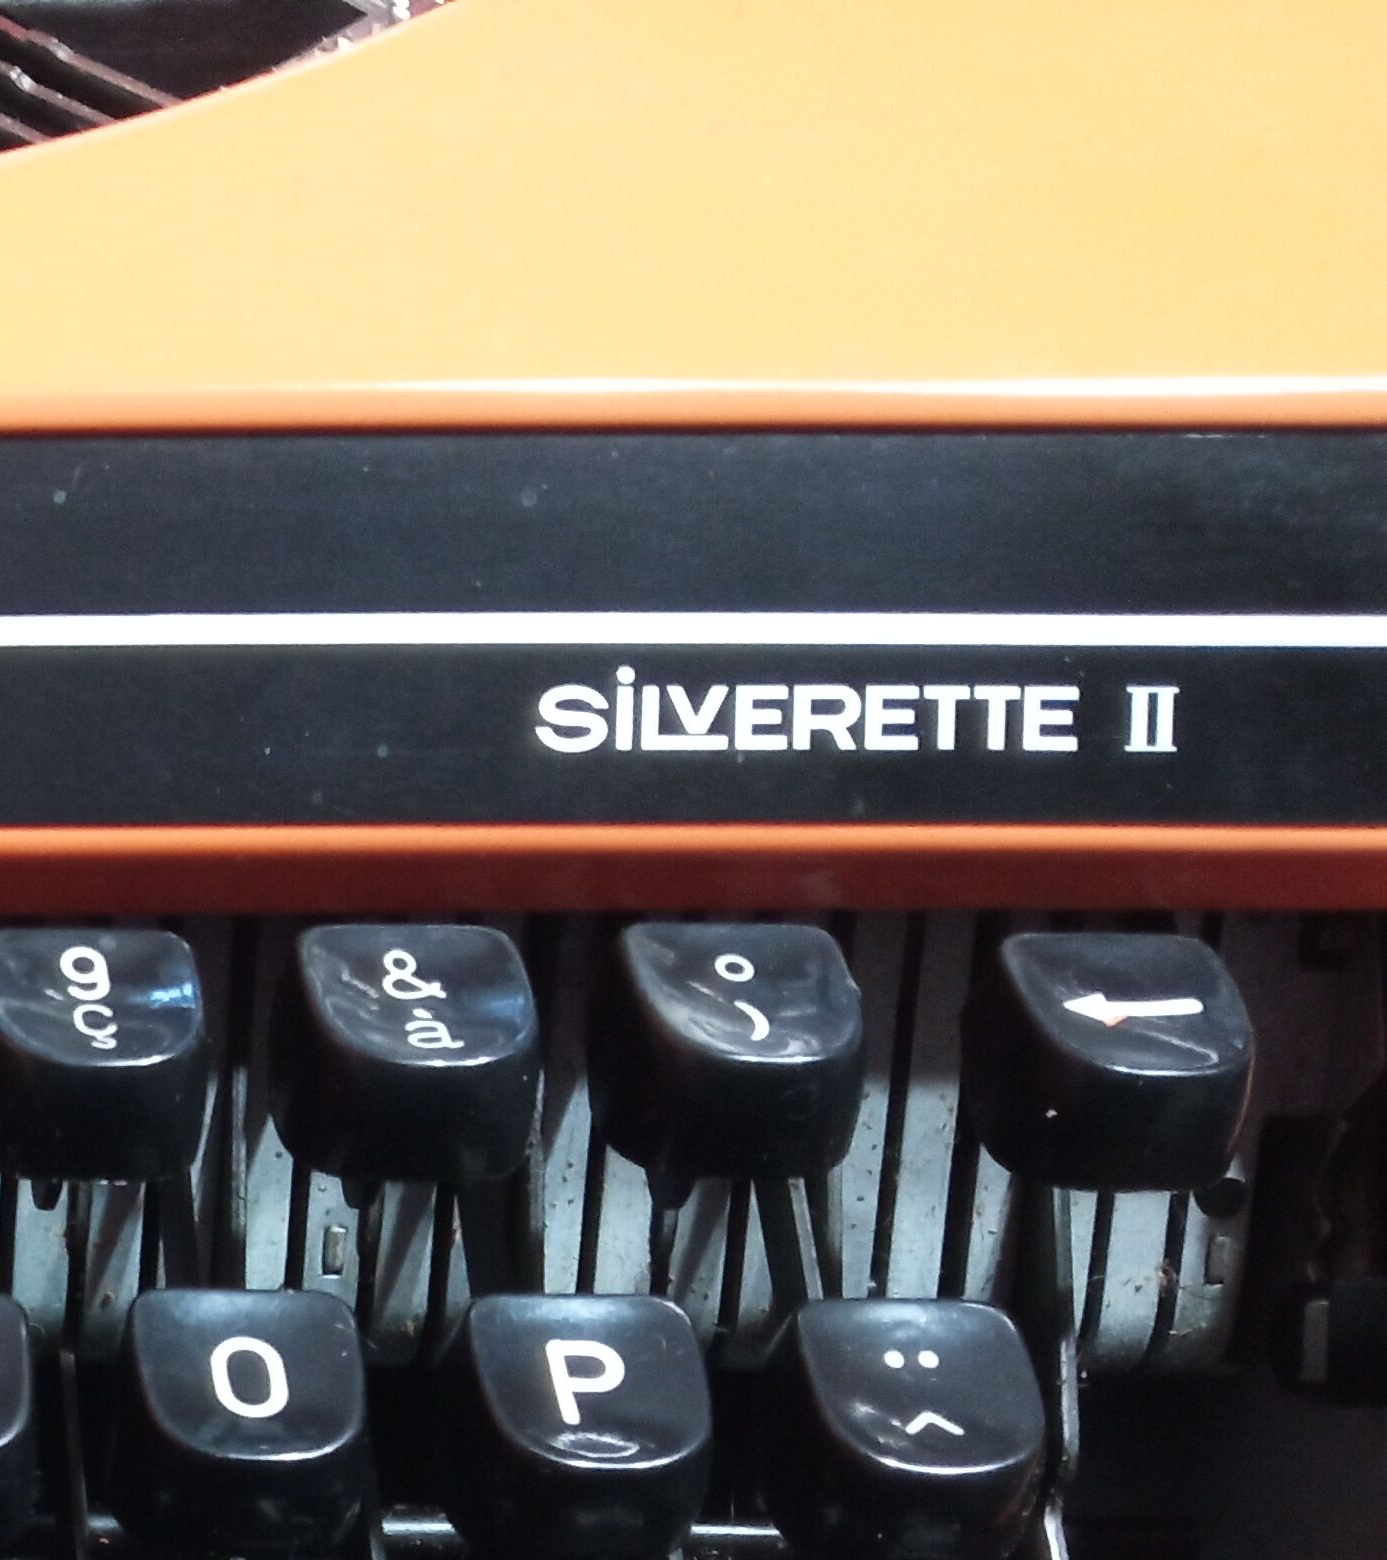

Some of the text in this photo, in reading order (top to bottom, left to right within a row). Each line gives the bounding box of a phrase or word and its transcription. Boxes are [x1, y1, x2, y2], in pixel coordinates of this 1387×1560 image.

[1123, 684, 1181, 753] II
[58, 945, 112, 1002] 9
[380, 947, 448, 1001] &
[71, 1002, 119, 1051] ç
[403, 1006, 466, 1050] à
[209, 1335, 290, 1420] O
[543, 1337, 626, 1427] P
